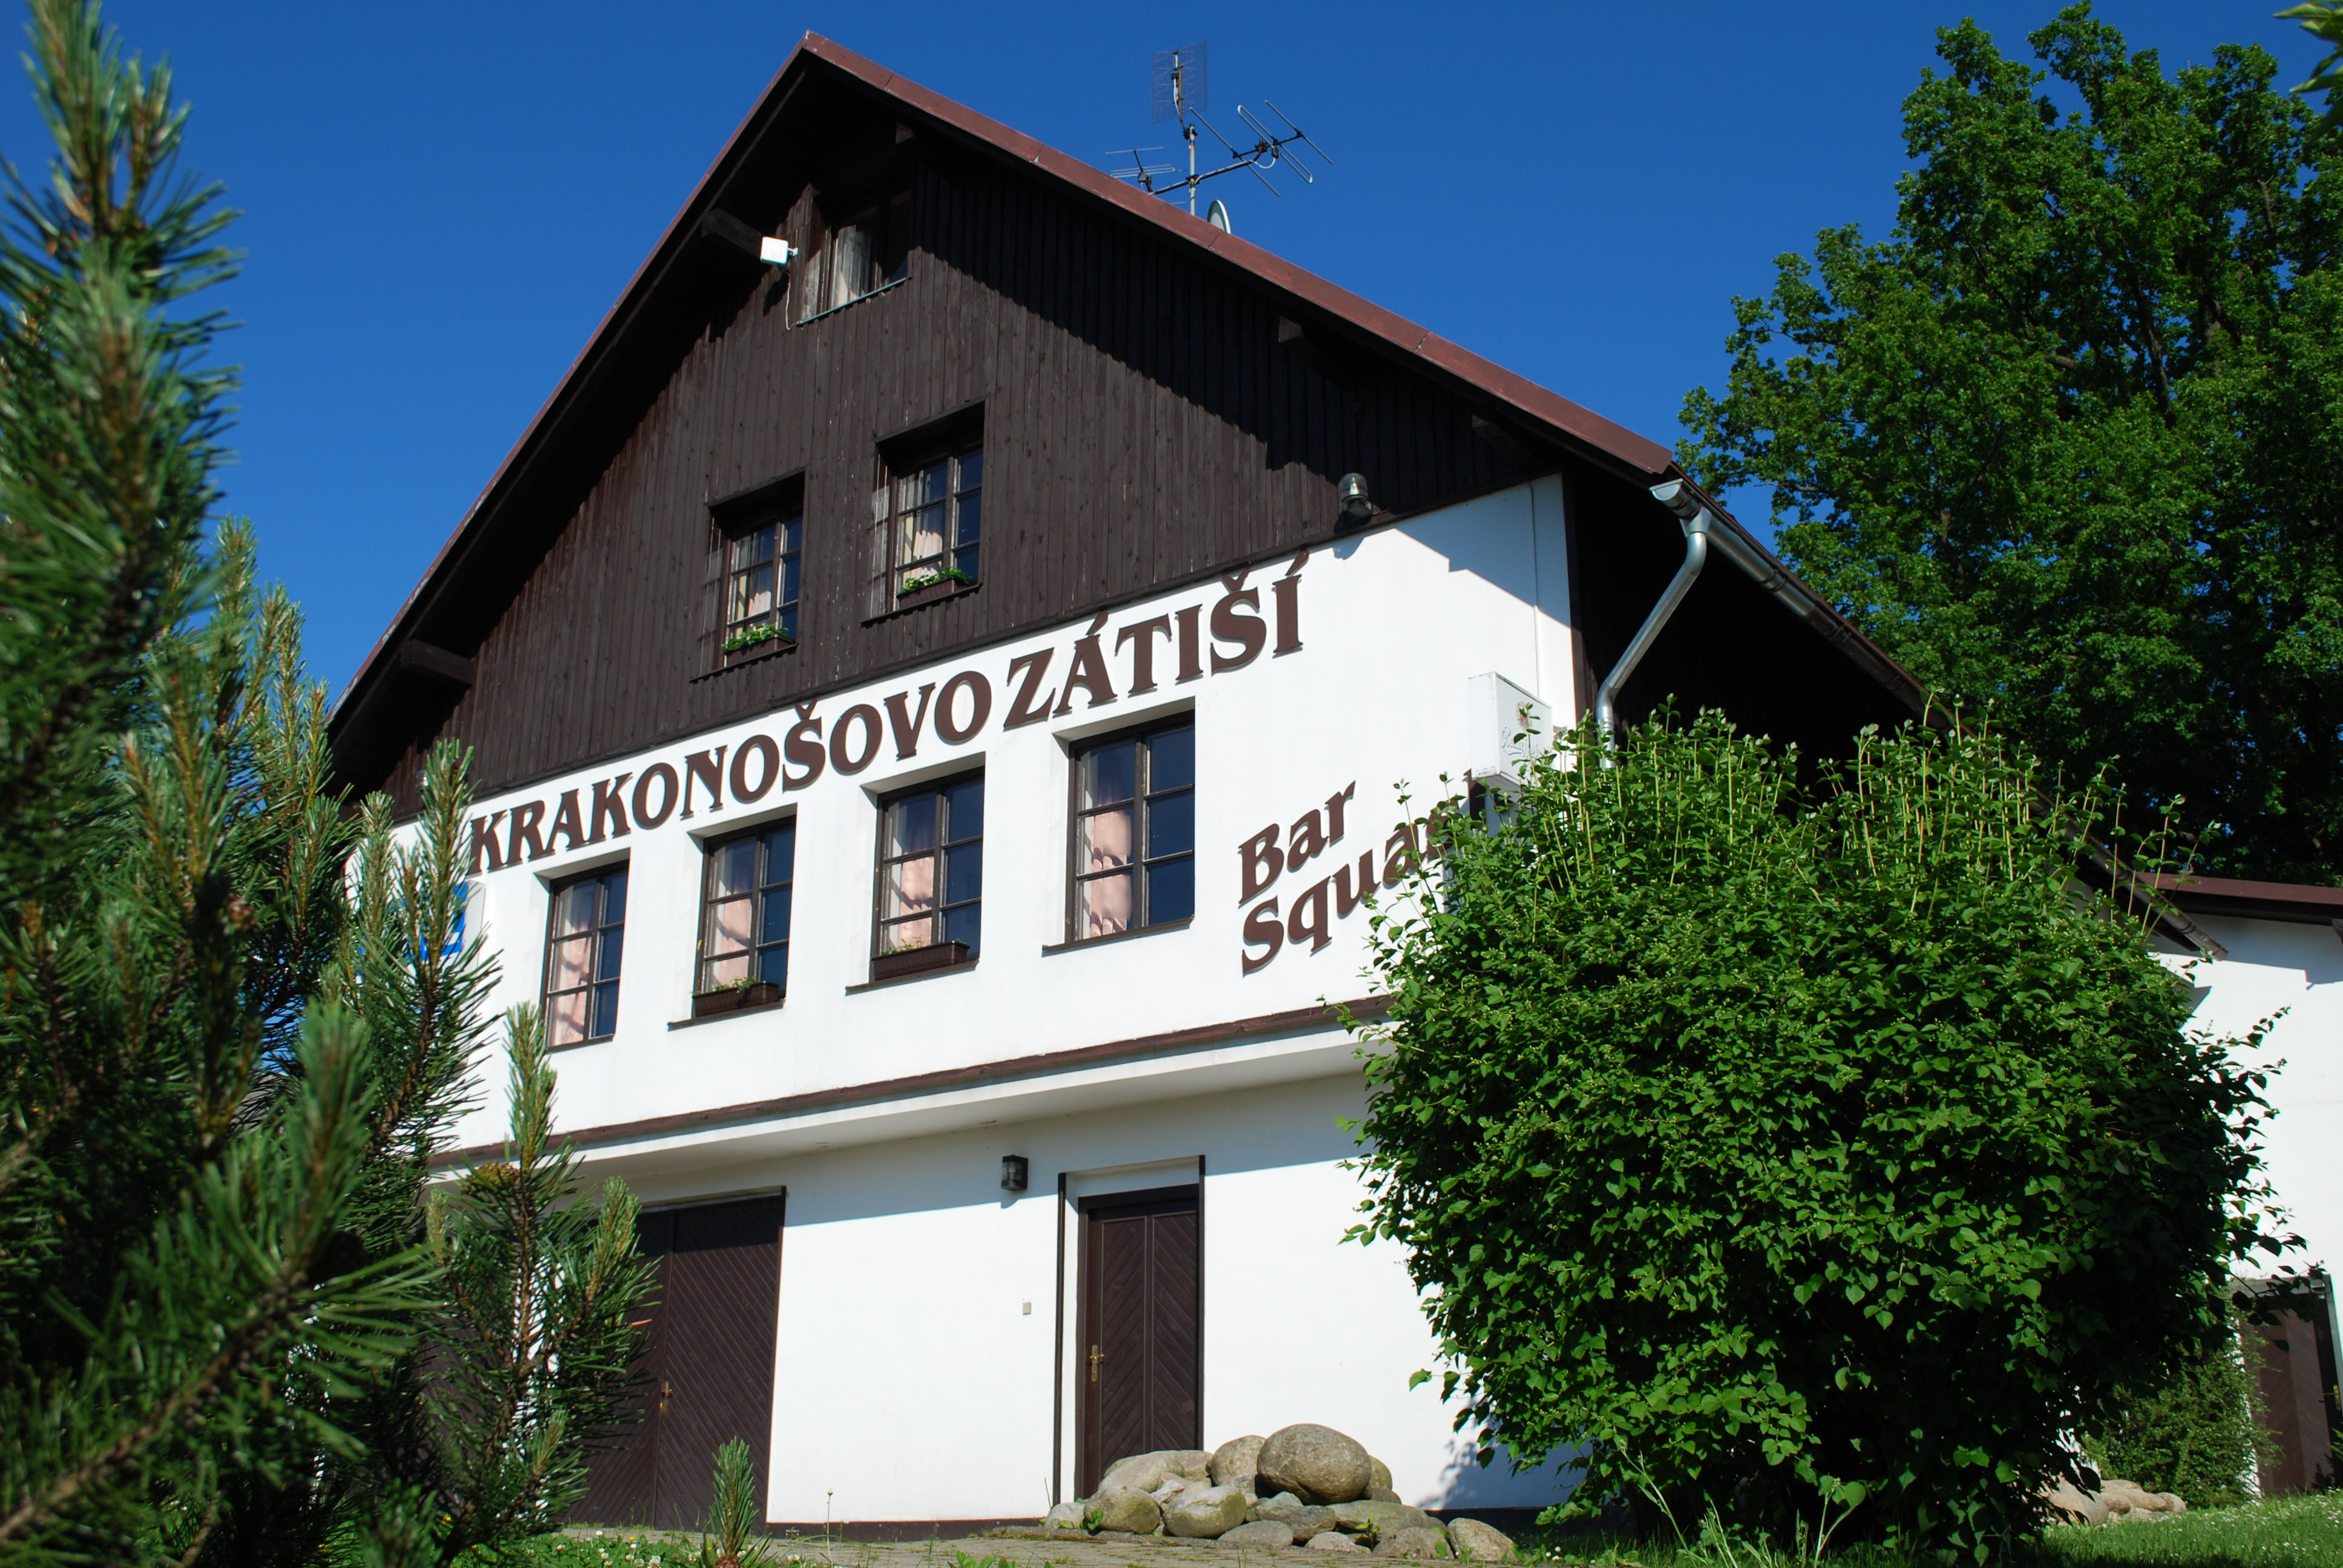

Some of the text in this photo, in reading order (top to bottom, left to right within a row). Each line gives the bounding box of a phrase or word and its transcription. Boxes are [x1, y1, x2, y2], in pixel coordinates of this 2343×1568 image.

[467, 550, 1309, 875] KRAKONOŠOVO ZÁTIŠÍ
[1239, 780, 1356, 904] Bar
